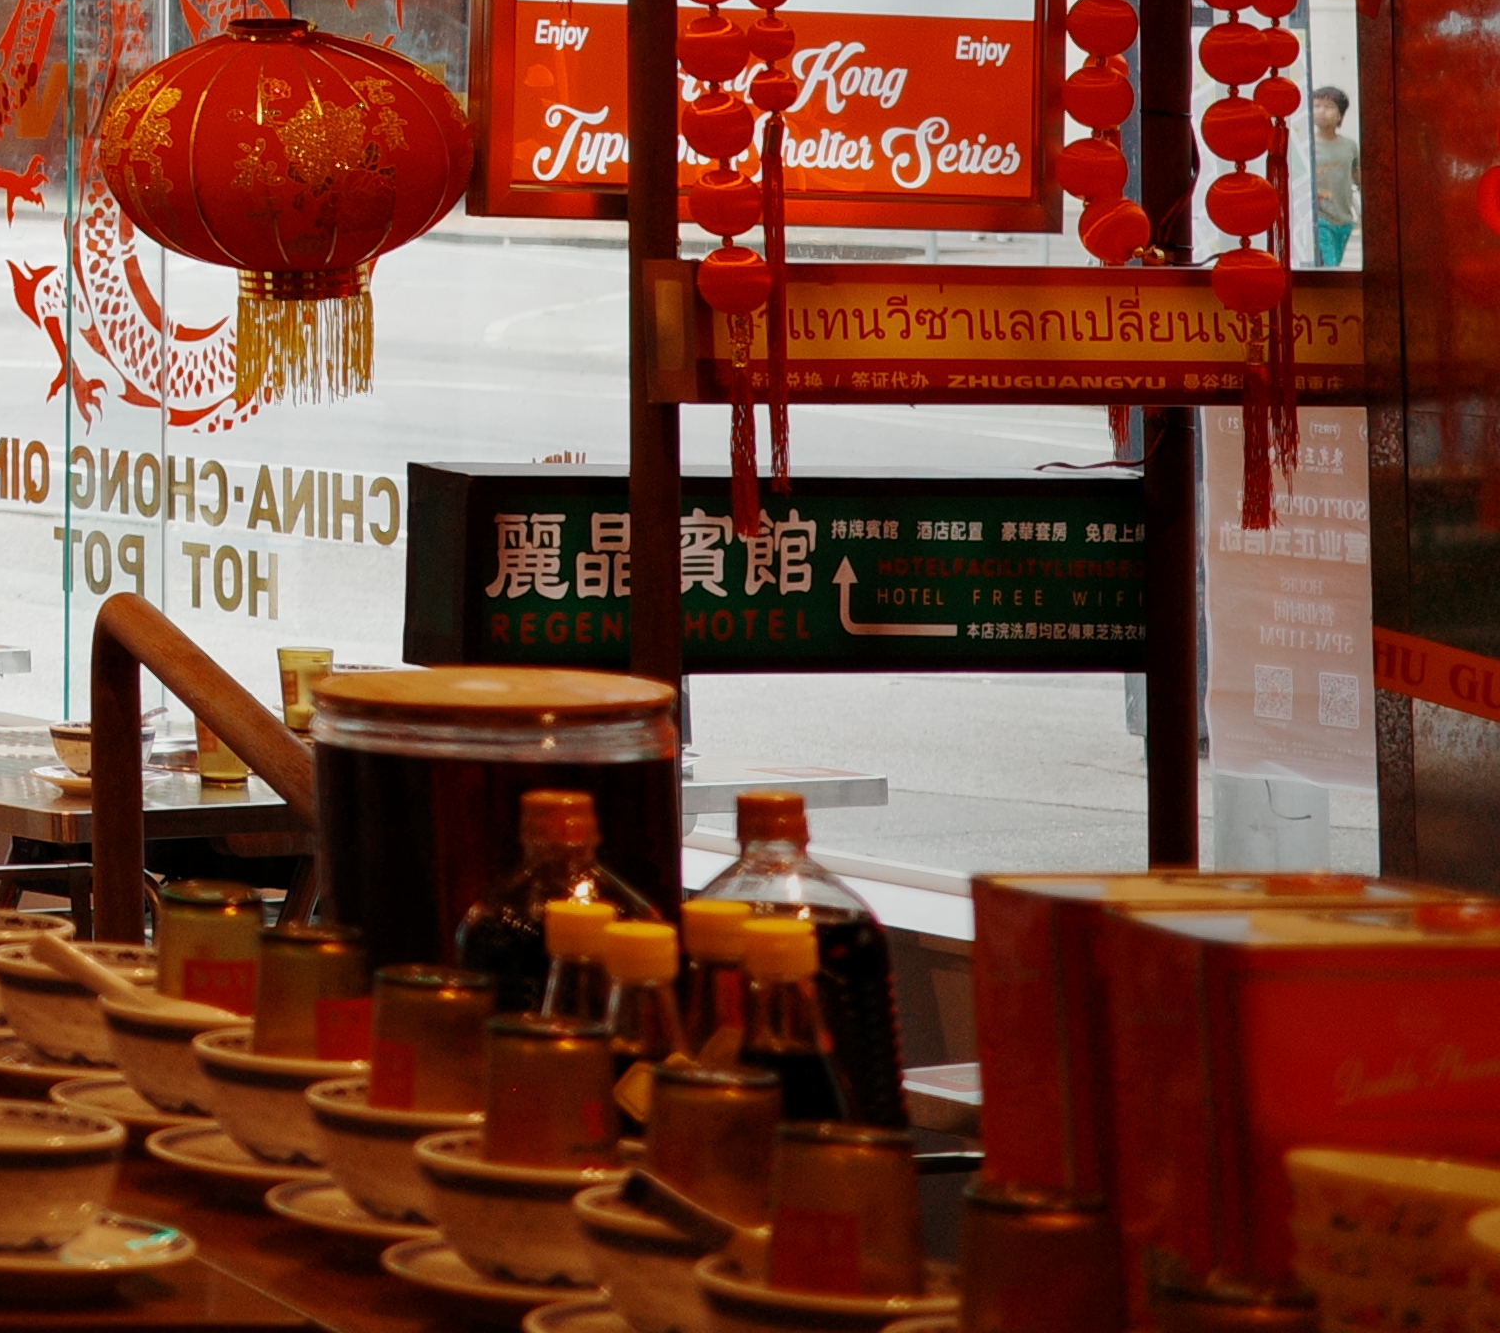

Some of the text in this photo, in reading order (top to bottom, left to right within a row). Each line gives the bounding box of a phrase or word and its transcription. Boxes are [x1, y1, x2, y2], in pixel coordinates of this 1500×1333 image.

[534, 18, 590, 51] Enjoy
[955, 35, 1011, 67] Enjoy
[789, 40, 910, 116] Kong
[881, 116, 1021, 190] Series
[947, 375, 1168, 390] ZHUGUANGYU
[916, 519, 984, 542] 酒店配置
[1000, 521, 1068, 543] 豪華套房
[484, 506, 819, 602] 麗晶賓館
[876, 588, 945, 607] HOTEL
[490, 611, 813, 647] REGEN HOTEL
